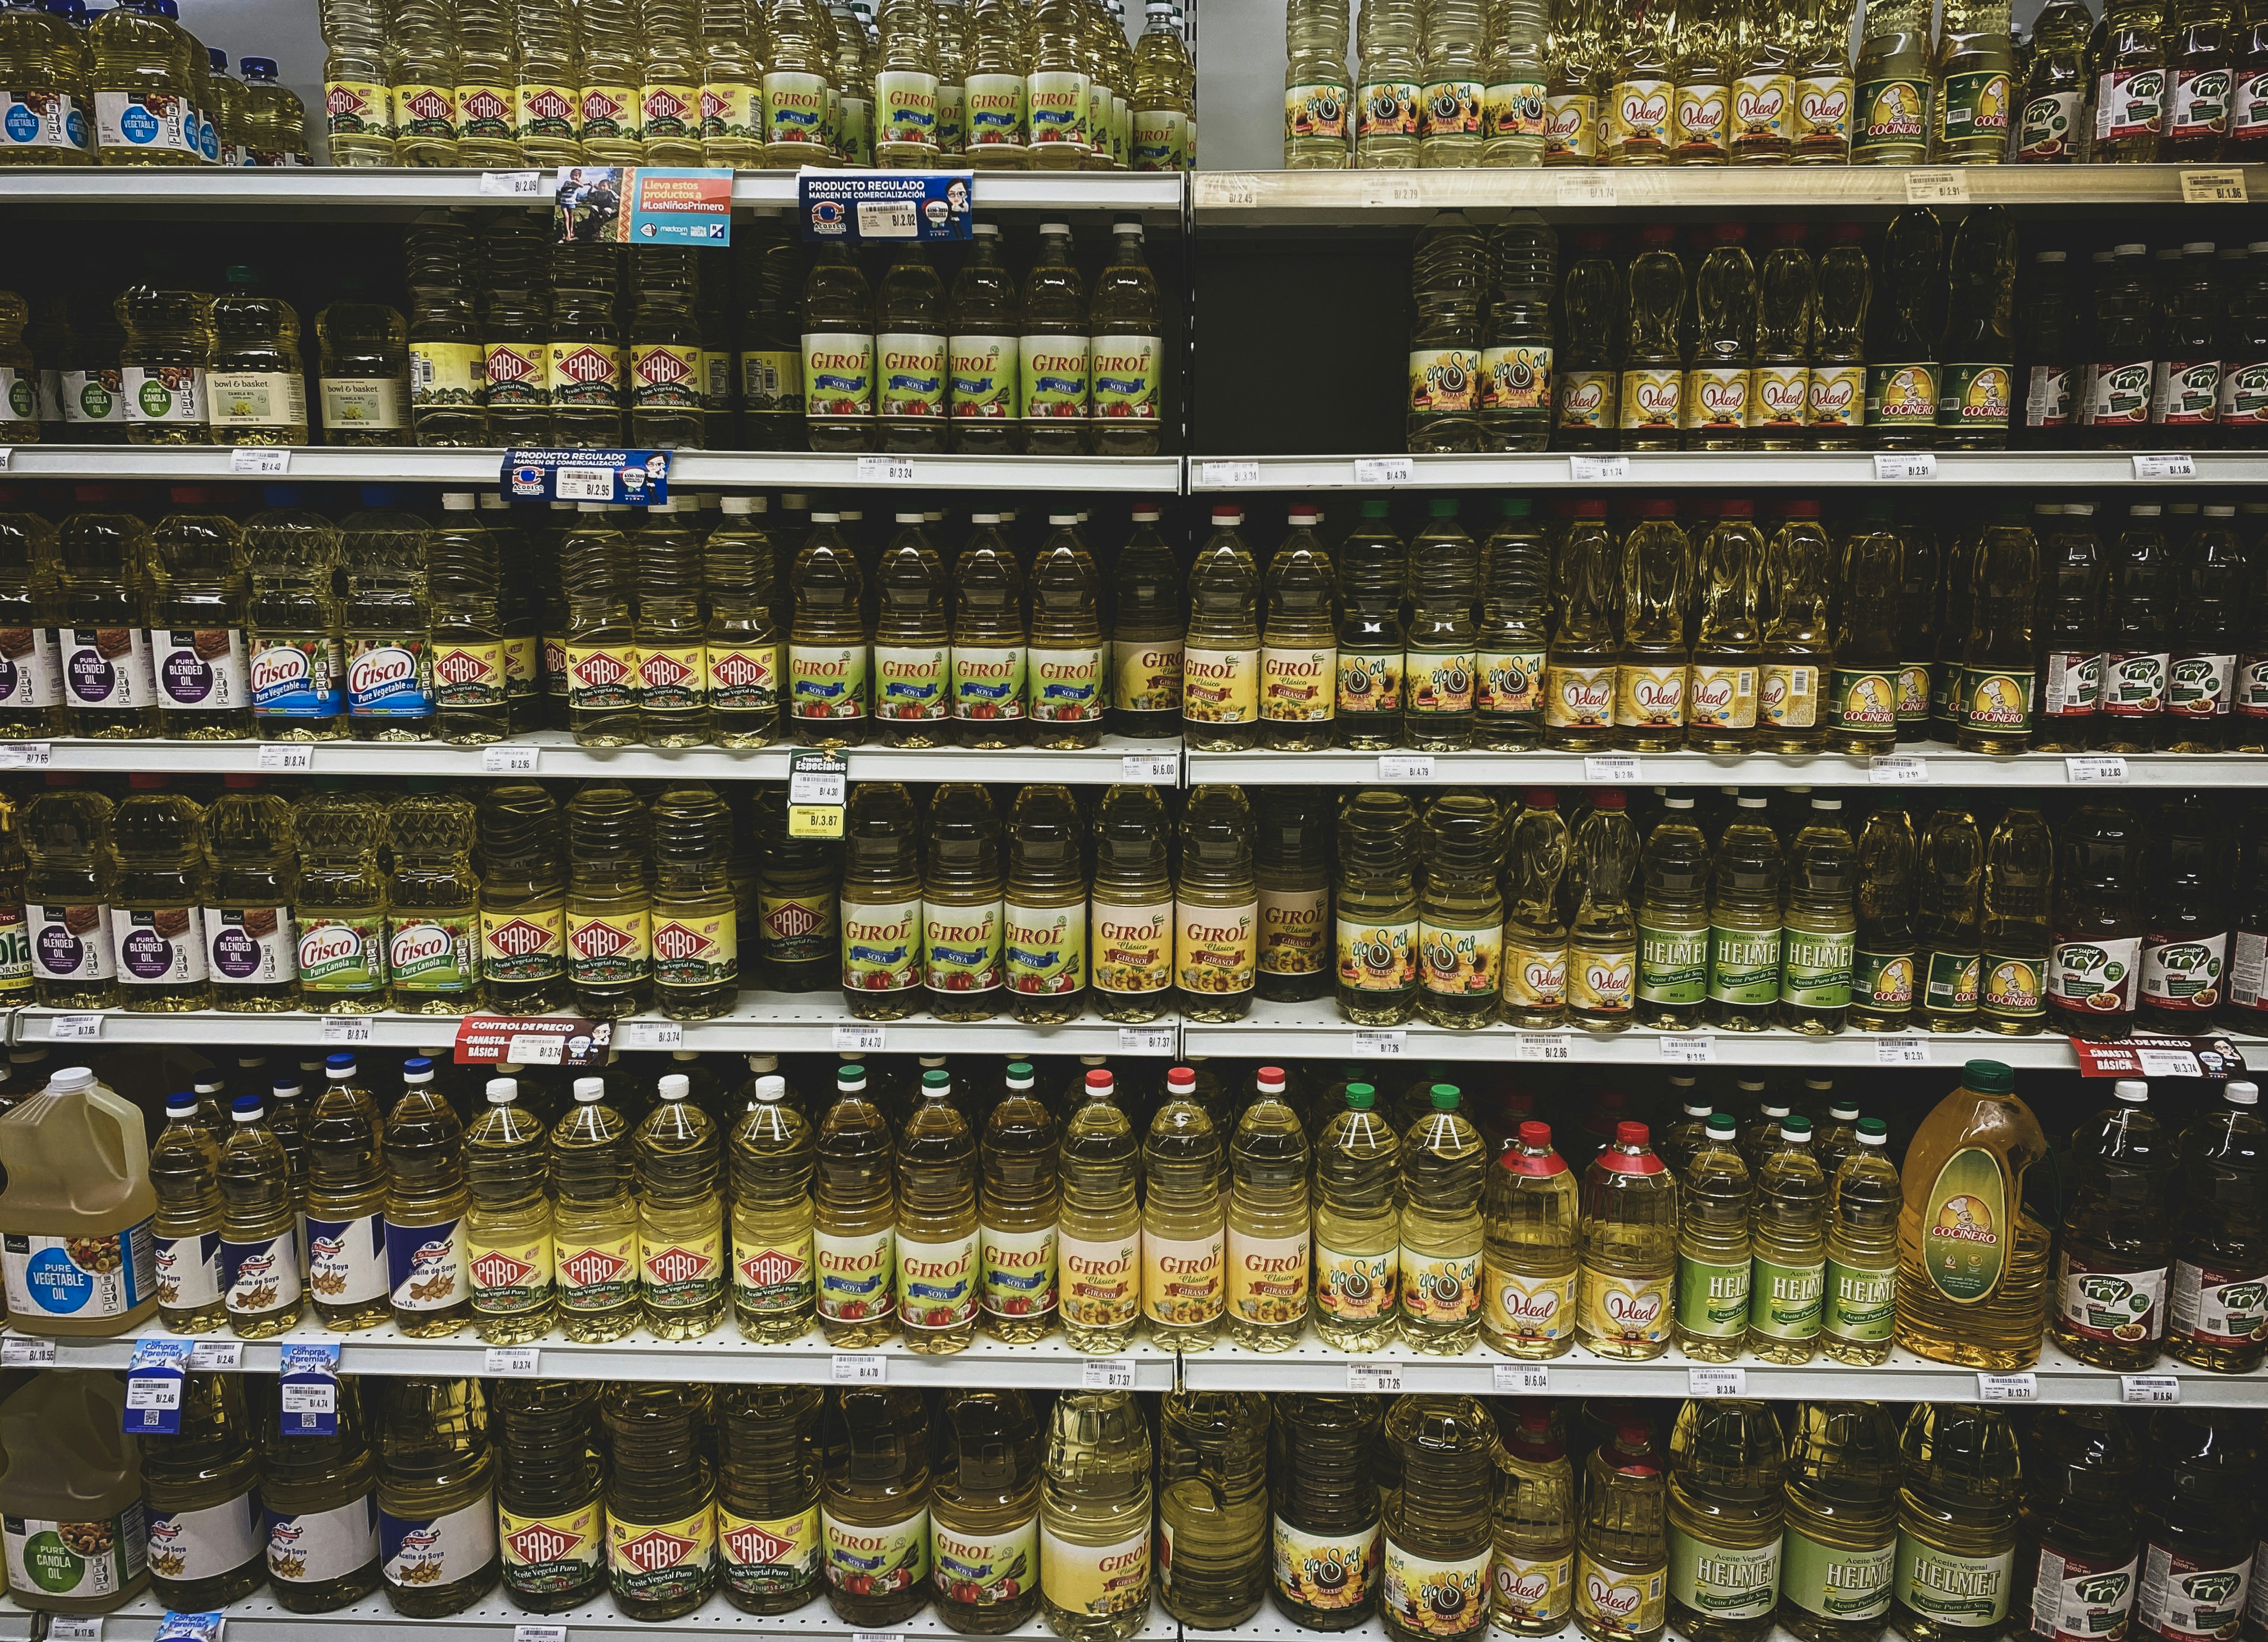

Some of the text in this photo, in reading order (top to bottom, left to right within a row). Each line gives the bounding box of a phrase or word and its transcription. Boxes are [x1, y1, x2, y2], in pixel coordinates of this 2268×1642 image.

[2132, 79, 2160, 98] Fry
[1030, 93, 1077, 107] GIROL
[470, 101, 501, 118] PABO
[1626, 102, 1663, 122] Ideal
[123, 120, 155, 130] VEGETABLE
[1868, 122, 1921, 137] COCINERO
[136, 129, 145, 138] OIL
[515, 181, 537, 193] B/.2.09
[645, 181, 670, 190] Lleva
[809, 181, 924, 191] PRODUCTO REGULADO
[1939, 186, 1960, 196] B/.2.91
[644, 191, 692, 200] productos
[1230, 193, 1252, 204] B/.2.45
[1394, 188, 1418, 199] B/.2.79
[1590, 187, 1614, 199] B/.1.74
[2217, 187, 2241, 199] B/.1.86
[642, 201, 724, 211] #LosNiñosPrimero
[892, 214, 915, 226] B/.2.02
[811, 353, 868, 369] GIROL
[569, 359, 606, 382] PABO
[831, 380, 850, 390] SOYA
[1706, 389, 1743, 407] Ideal
[262, 462, 281, 471] B/.4.40
[1602, 467, 1622, 477] B/.1.74
[1909, 466, 1928, 476] B/.2.91
[2170, 466, 2190, 475] B/.1.86
[889, 467, 912, 479] B/.3.24
[1235, 471, 1257, 482] B/.3.34
[1387, 470, 1406, 480] B/.4.79
[587, 484, 609, 495] B/.2.95
[74, 664, 105, 674] BLENDED
[442, 660, 479, 680] PABO
[582, 662, 619, 682] PABO
[792, 659, 848, 675] GIROL
[1266, 659, 1321, 676] GIROL
[2124, 664, 2156, 681] Fry
[85, 675, 96, 685] OIL
[358, 684, 404, 703] Pure Vegetable
[808, 687, 826, 696] SOYA
[1278, 688, 1306, 700] GIRASOL
[1570, 687, 1608, 706] Ideal
[1844, 711, 1893, 722] COCINERO
[26, 754, 48, 764] B/.7.65
[285, 756, 305, 766] B/.8.74
[511, 760, 529, 768] B/.2.95
[796, 761, 845, 771] Especiales
[1153, 764, 1174, 775] B/.6.00
[1410, 767, 1428, 776] B/.4.79
[2100, 767, 2121, 777] B/.2.83
[811, 816, 837, 825] B/.3.87
[1102, 922, 1162, 940] GIROL
[500, 931, 541, 953] PABO
[2062, 950, 2099, 974] Fry
[310, 960, 349, 977] Pure Canola
[1987, 993, 2037, 1006] COCINERO
[78, 1026, 95, 1035] B/.7.65
[471, 1022, 521, 1030] CONTROL
[538, 1023, 574, 1032] PRECIO
[347, 1030, 368, 1040] B/.8.74
[466, 1035, 505, 1045] CANASTA
[659, 1032, 680, 1043] B/.3.74
[861, 1037, 881, 1047] B/.4.70
[1149, 1037, 1169, 1047] B/.7.37
[468, 1045, 498, 1057] BÁSICA
[540, 1048, 561, 1057] B/.3.74
[1380, 1043, 1398, 1053] B/.7.26
[1546, 1047, 1567, 1058] B/.2.86
[2097, 1059, 2132, 1070] BÁSICA
[2174, 1064, 2197, 1072] B/.3.74
[1932, 1226, 1997, 1243] COCINERO
[45, 1264, 71, 1273] PURE
[904, 1256, 970, 1277] GIROL
[1160, 1255, 1220, 1274] GIROL
[478, 1261, 517, 1283] PABO
[33, 1273, 84, 1287] VEGETABLE
[52, 1287, 67, 1300] OIL
[928, 1289, 948, 1298] SOYA
[2084, 1281, 2124, 1305] Fry
[1507, 1294, 1553, 1318] Ideal
[29, 1350, 53, 1361] B/.18.55
[512, 1360, 530, 1370] B/.3.74
[860, 1367, 878, 1378] B/.4.70
[1109, 1373, 1130, 1385] B/.7.37
[1379, 1378, 1400, 1390] B/.7.26
[1525, 1375, 1546, 1387] B/.6.04
[1717, 1385, 1735, 1395] B/.3.84
[2008, 1388, 2030, 1398] B/.13.71
[156, 1394, 174, 1403] B/.2.46
[829, 1528, 884, 1551] GIROL
[40, 1546, 65, 1554] PURE
[430, 1551, 444, 1559] Soya
[518, 1537, 562, 1562] PABO
[37, 1554, 71, 1568] CANOLA
[1715, 1553, 1766, 1562] Aceite Vegetal
[48, 1568, 62, 1580] OIL
[1698, 1557, 1776, 1589] HELMET
[1591, 1584, 1634, 1611] Ideal
[2085, 1581, 2121, 1605] Fry
